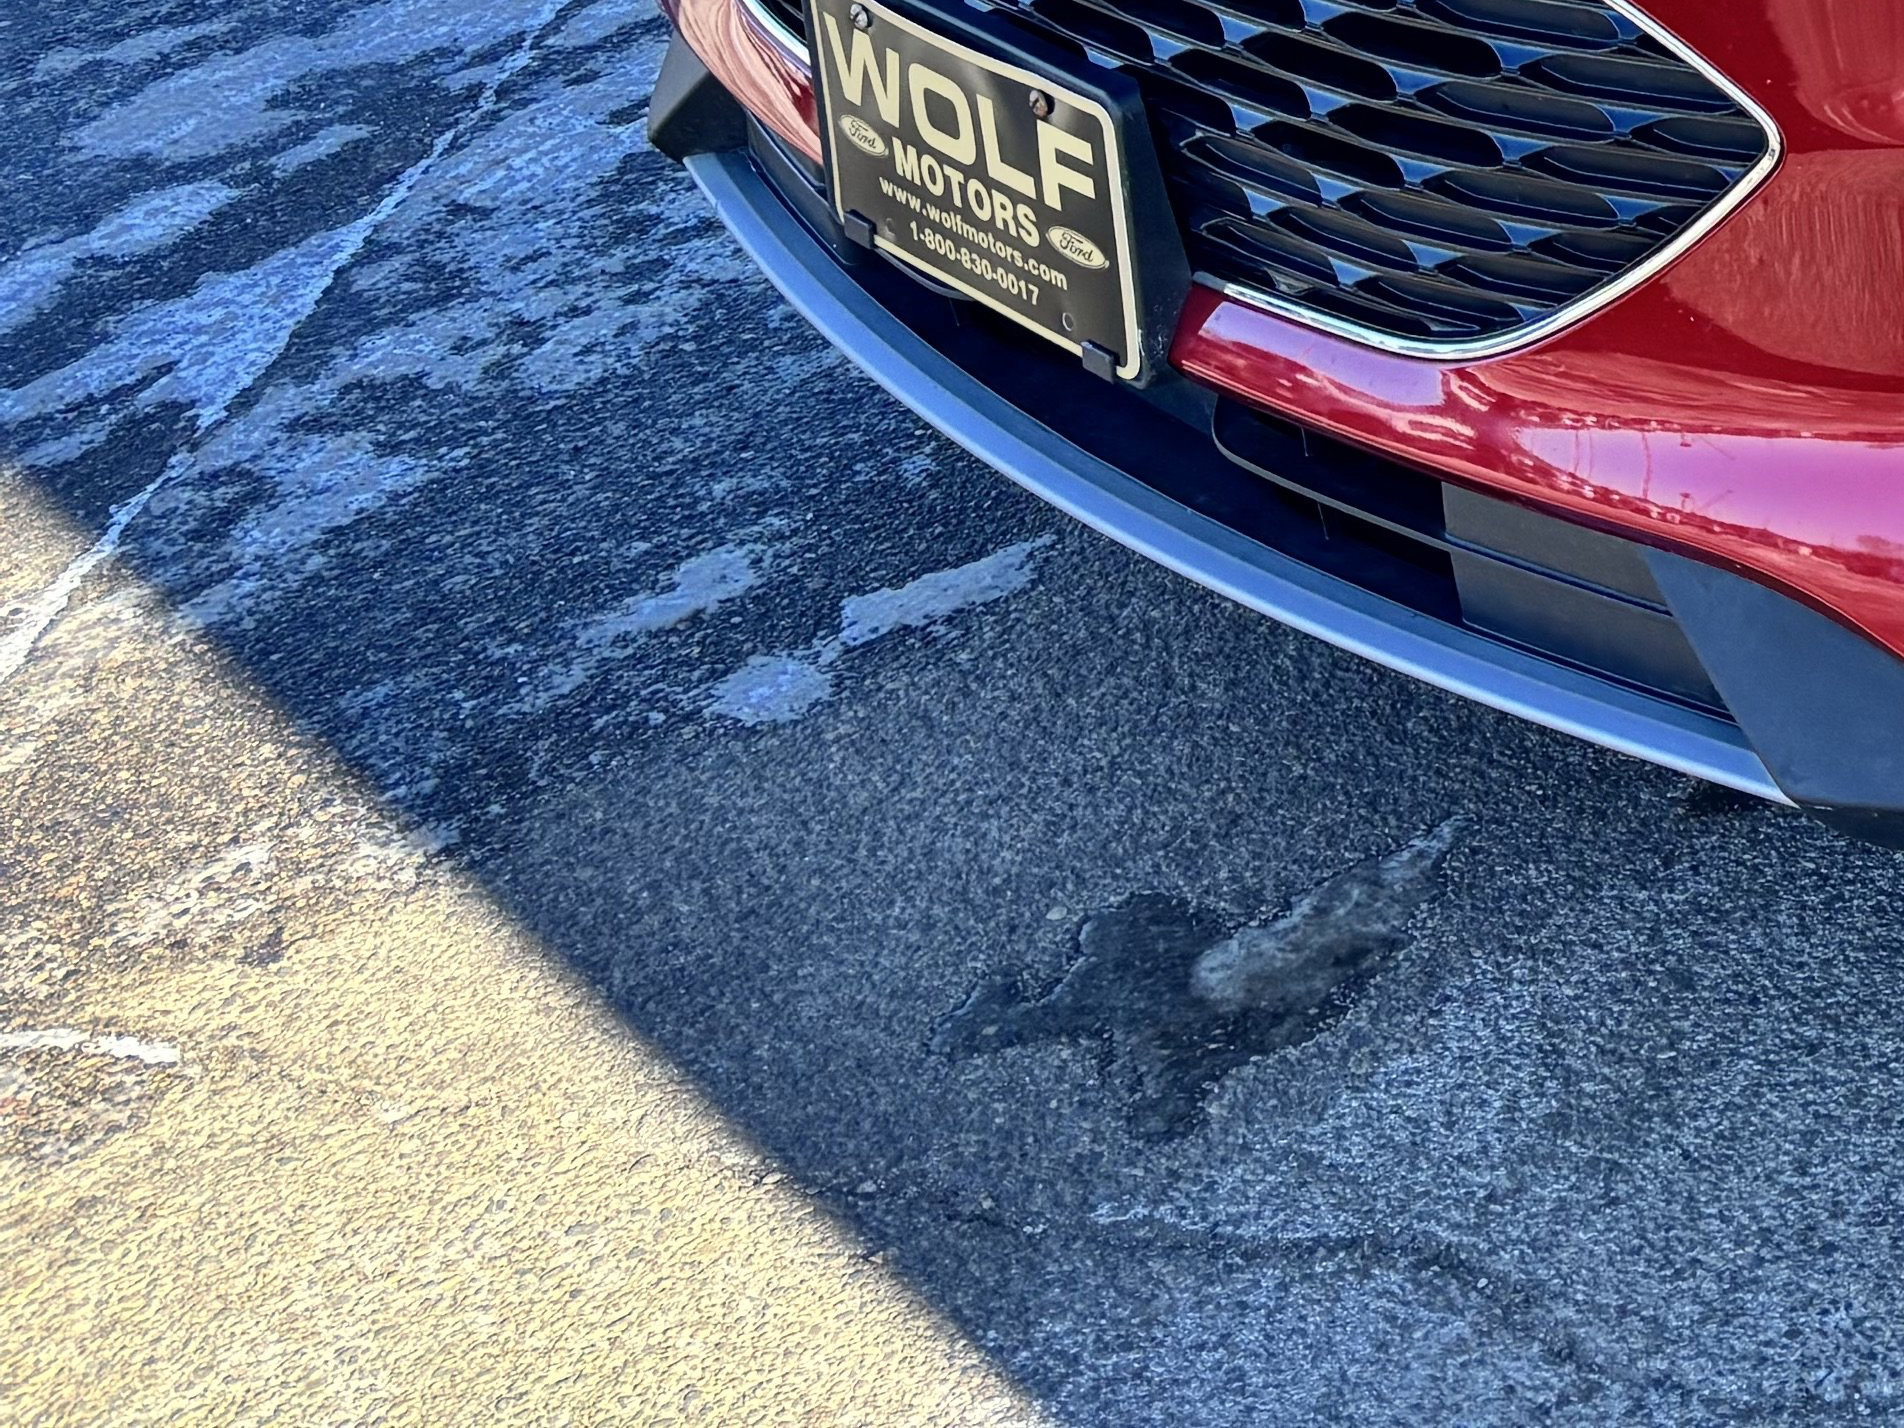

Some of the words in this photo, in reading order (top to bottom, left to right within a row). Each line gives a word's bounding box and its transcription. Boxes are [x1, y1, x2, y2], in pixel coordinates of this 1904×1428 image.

[823, 11, 1096, 211] WOLF
[879, 176, 1068, 291] www.wolfmotors.com
[892, 136, 1041, 248] MOTORS
[910, 221, 1041, 306] 1-800-830-0017
